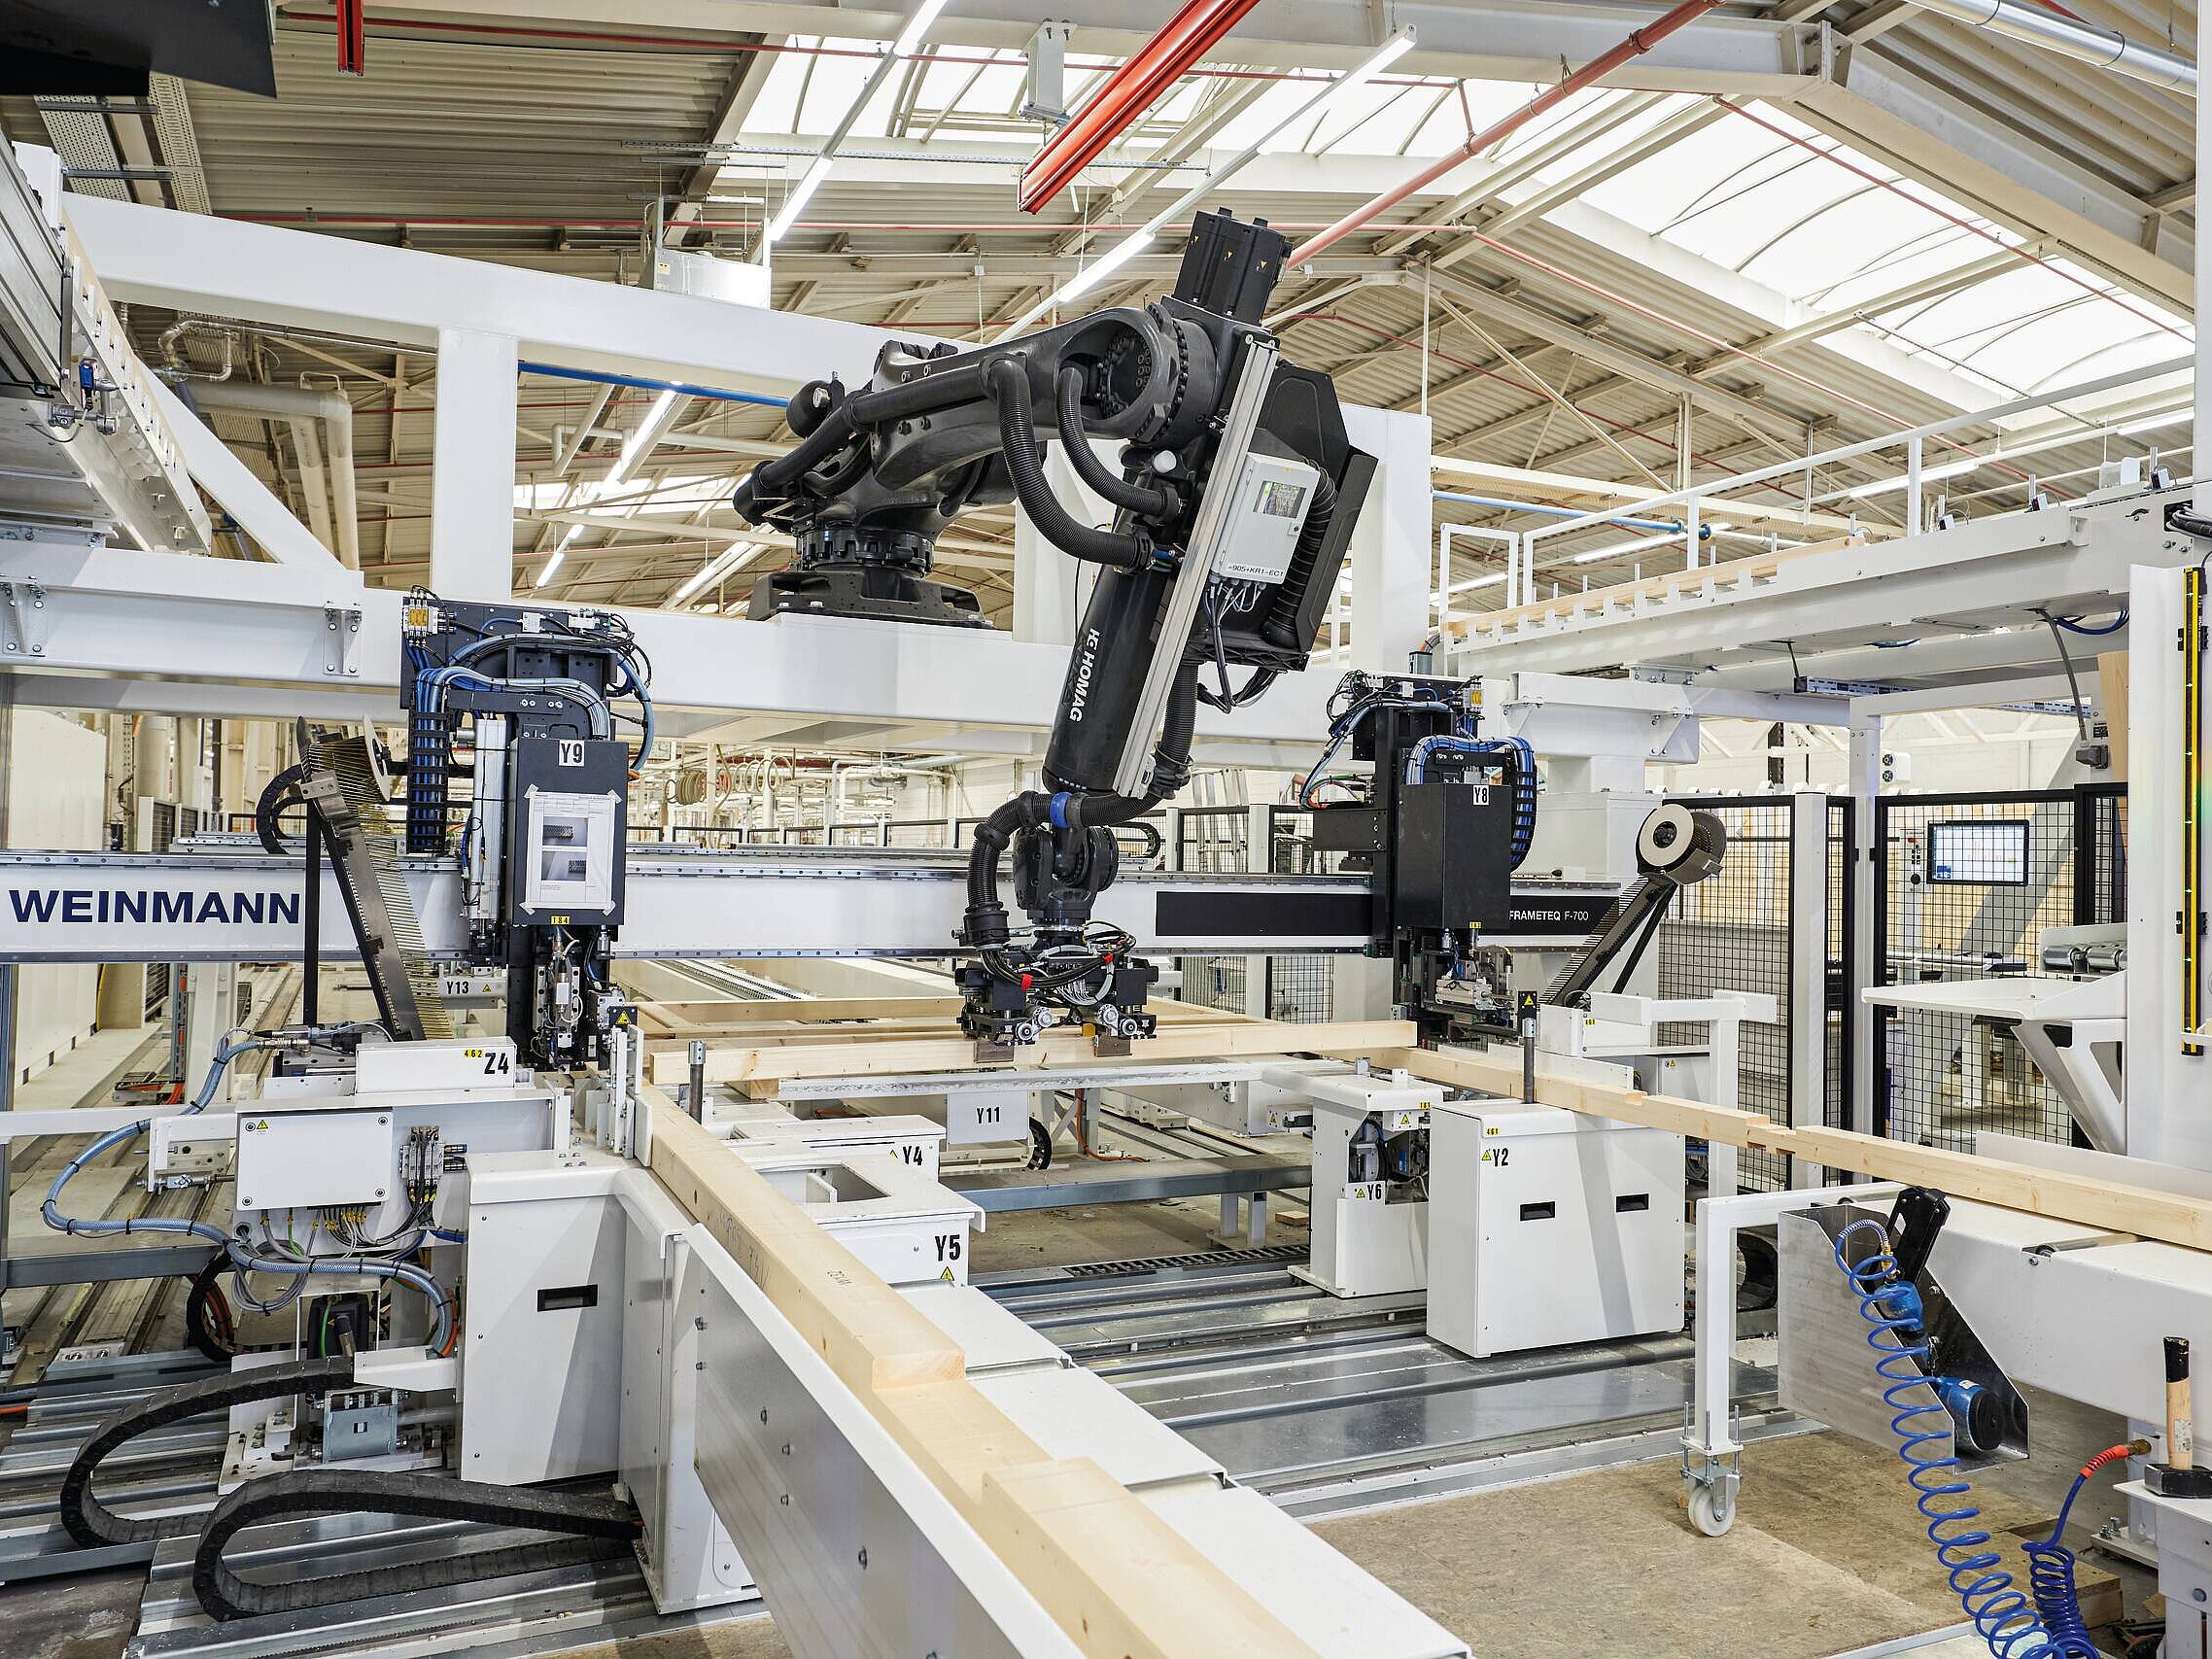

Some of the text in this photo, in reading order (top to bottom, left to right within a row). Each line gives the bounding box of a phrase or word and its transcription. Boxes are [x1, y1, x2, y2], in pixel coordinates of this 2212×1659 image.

[1069, 650, 1095, 723] HOMAG
[561, 743, 582, 764] Y9
[1474, 788, 1488, 804] Y8
[9, 890, 299, 924] WEINMANN
[1509, 910, 1589, 921] FRAMETEQ F-700
[446, 981, 469, 995] Y13
[464, 1050, 483, 1058] 462
[484, 1052, 509, 1075] Z4
[977, 1106, 1000, 1123] Y11
[903, 1145, 923, 1166] Y4
[1493, 1147, 1508, 1167] Y2
[1366, 1183, 1382, 1201] Y6
[935, 1233, 961, 1262] Y5
